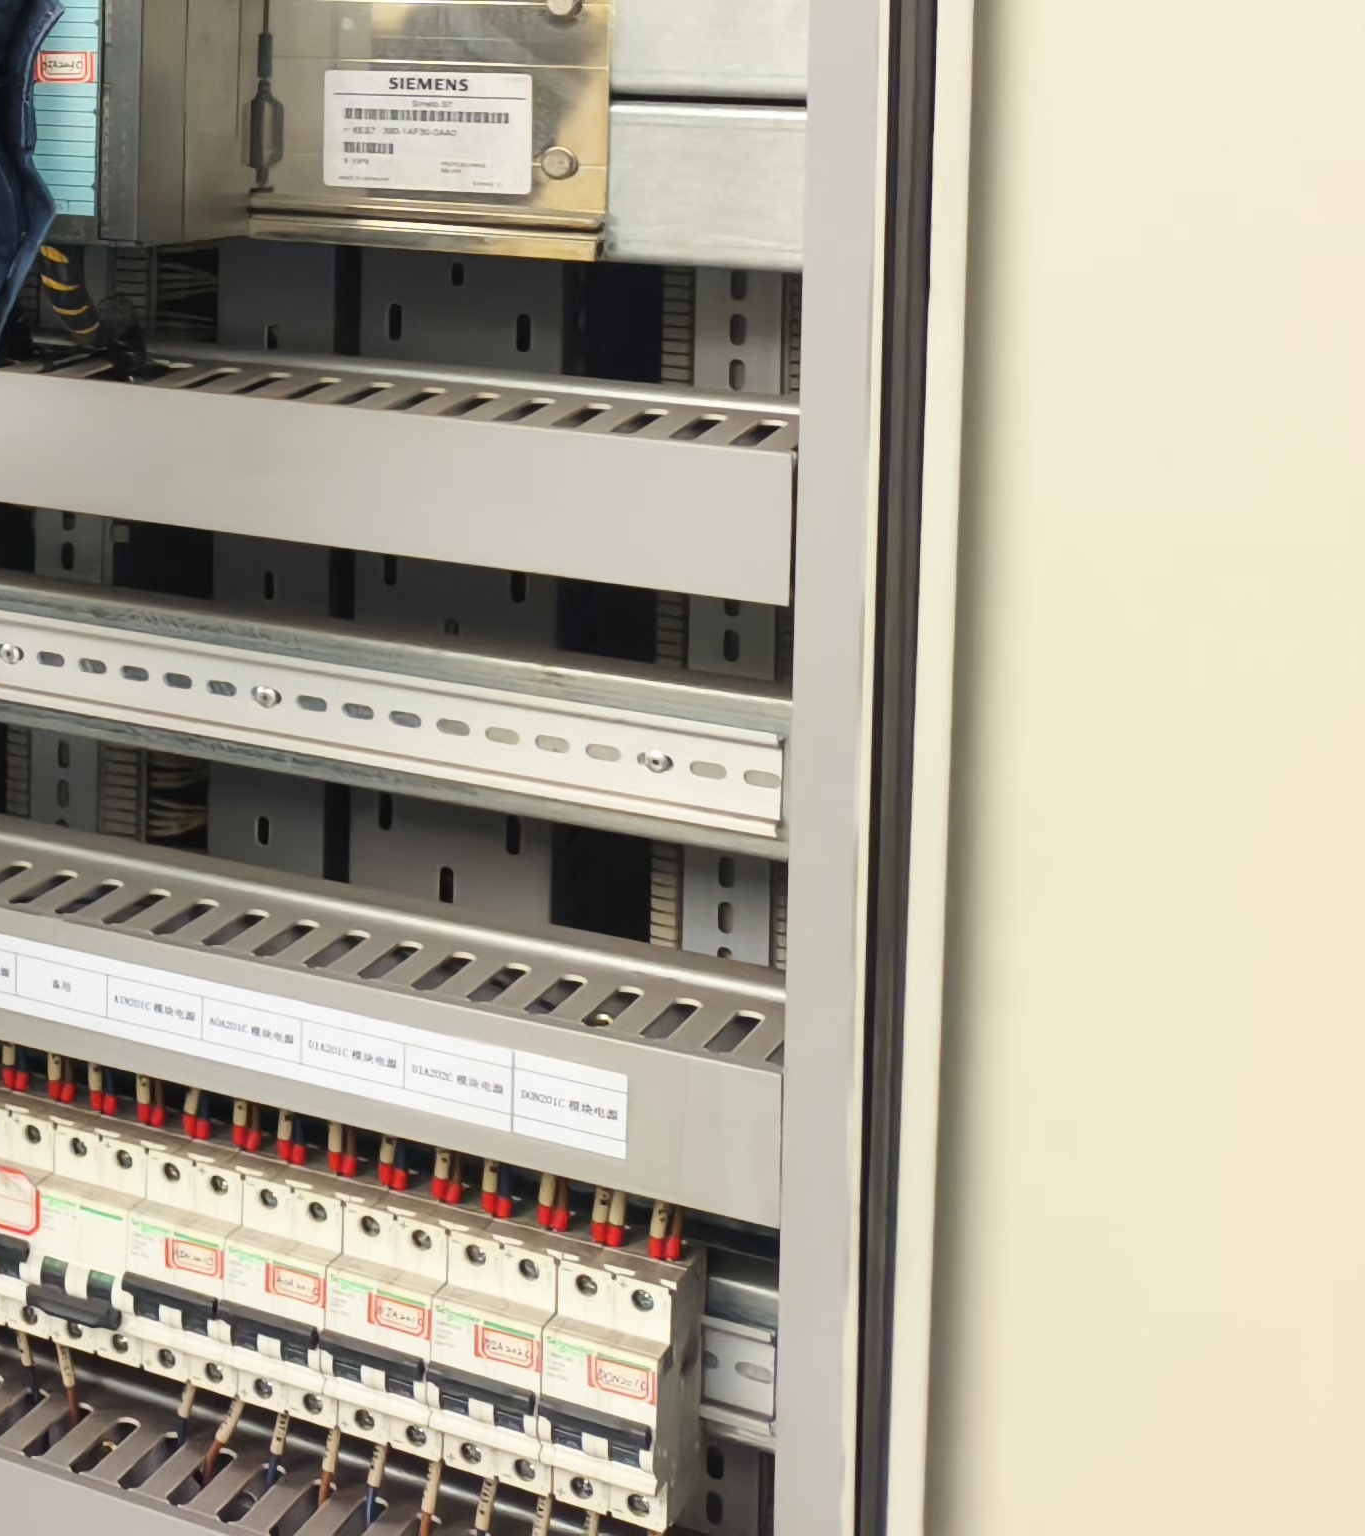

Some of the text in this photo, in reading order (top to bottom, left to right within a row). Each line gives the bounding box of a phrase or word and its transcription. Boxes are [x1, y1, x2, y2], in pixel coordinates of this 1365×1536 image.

[388, 77, 469, 92] SIEMENS
[154, 1003, 196, 1022] 模块电源
[251, 1026, 294, 1045] 模块电源
[351, 1049, 397, 1069] 模块电源
[457, 1074, 504, 1094] 模块电源
[569, 1099, 618, 1121] 模块电源
